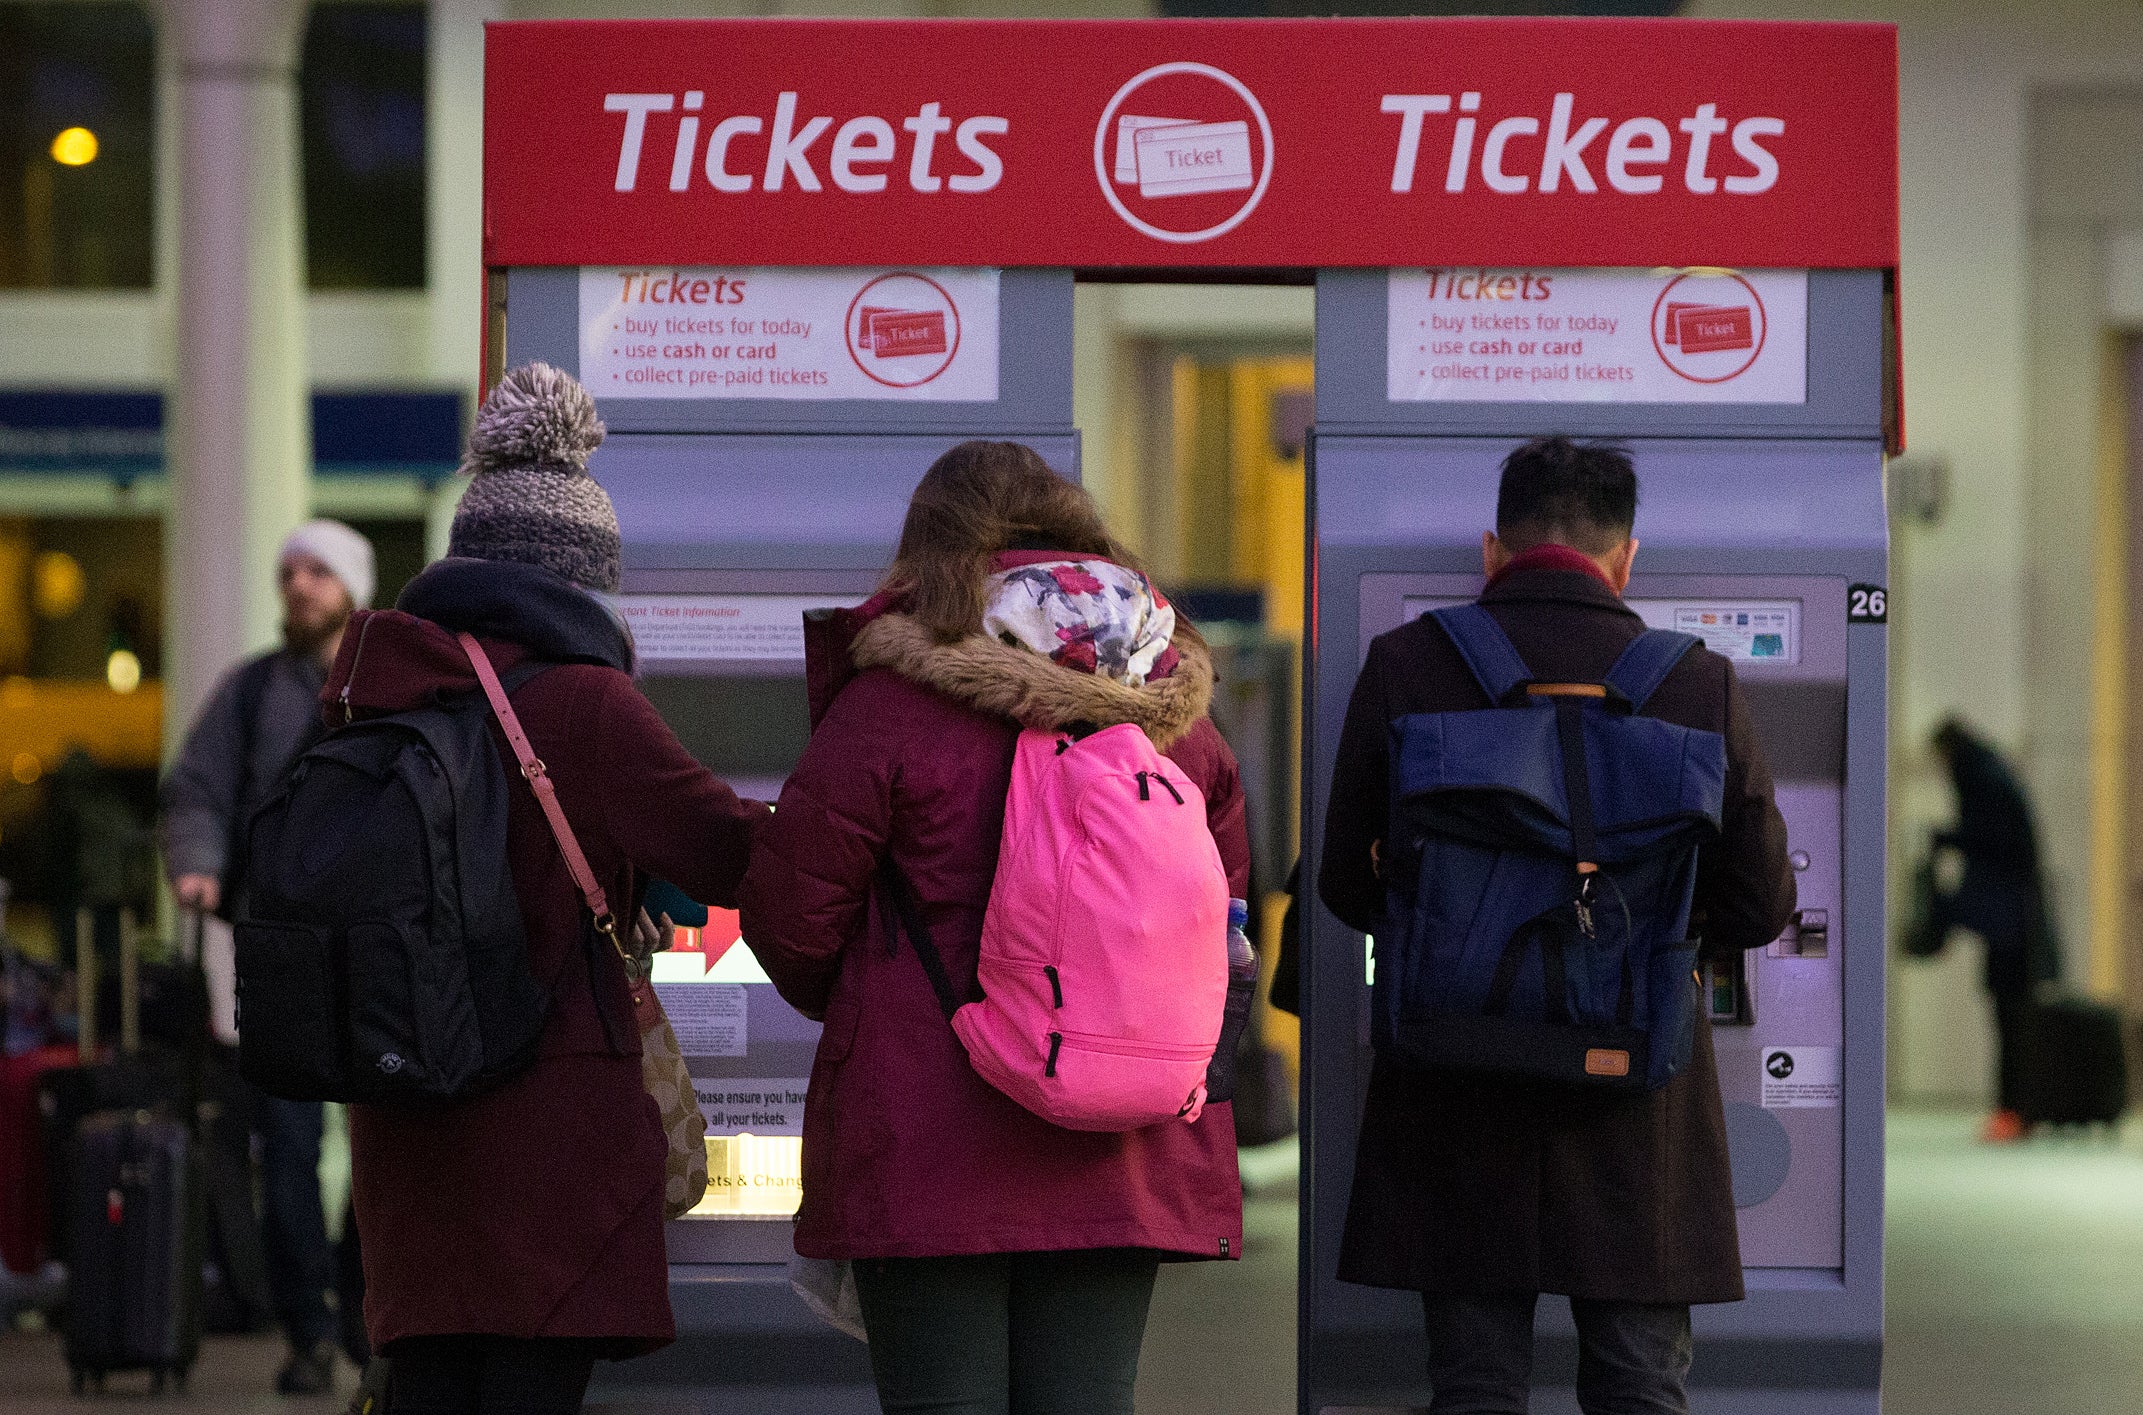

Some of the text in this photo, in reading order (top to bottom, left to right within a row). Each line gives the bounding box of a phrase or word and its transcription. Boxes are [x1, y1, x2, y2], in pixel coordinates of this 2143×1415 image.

[603, 90, 1009, 193] Tickets
[1380, 91, 1786, 194] Tickets
[1164, 147, 1223, 168] Ticket
[618, 270, 747, 304] Tickets
[1424, 266, 1554, 300] Tickets
[625, 316, 811, 338] buy tickets for today
[890, 326, 929, 341] Ticket
[1431, 313, 1619, 335] buy tickets for today
[1696, 322, 1736, 336] Ticket
[625, 341, 777, 360] use cash or card
[1431, 338, 1584, 356] use cash or card
[625, 367, 829, 387] collect pre-paid tickets
[1431, 363, 1634, 383] collect pre-paid tickets
[652, 606, 680, 617] Ticket
[1851, 590, 1886, 617] 26
[727, 1092, 761, 1104] ensure
[764, 1093, 783, 1107] you
[712, 1112, 787, 1128] all your tickets.
[737, 1174, 748, 1187] &
